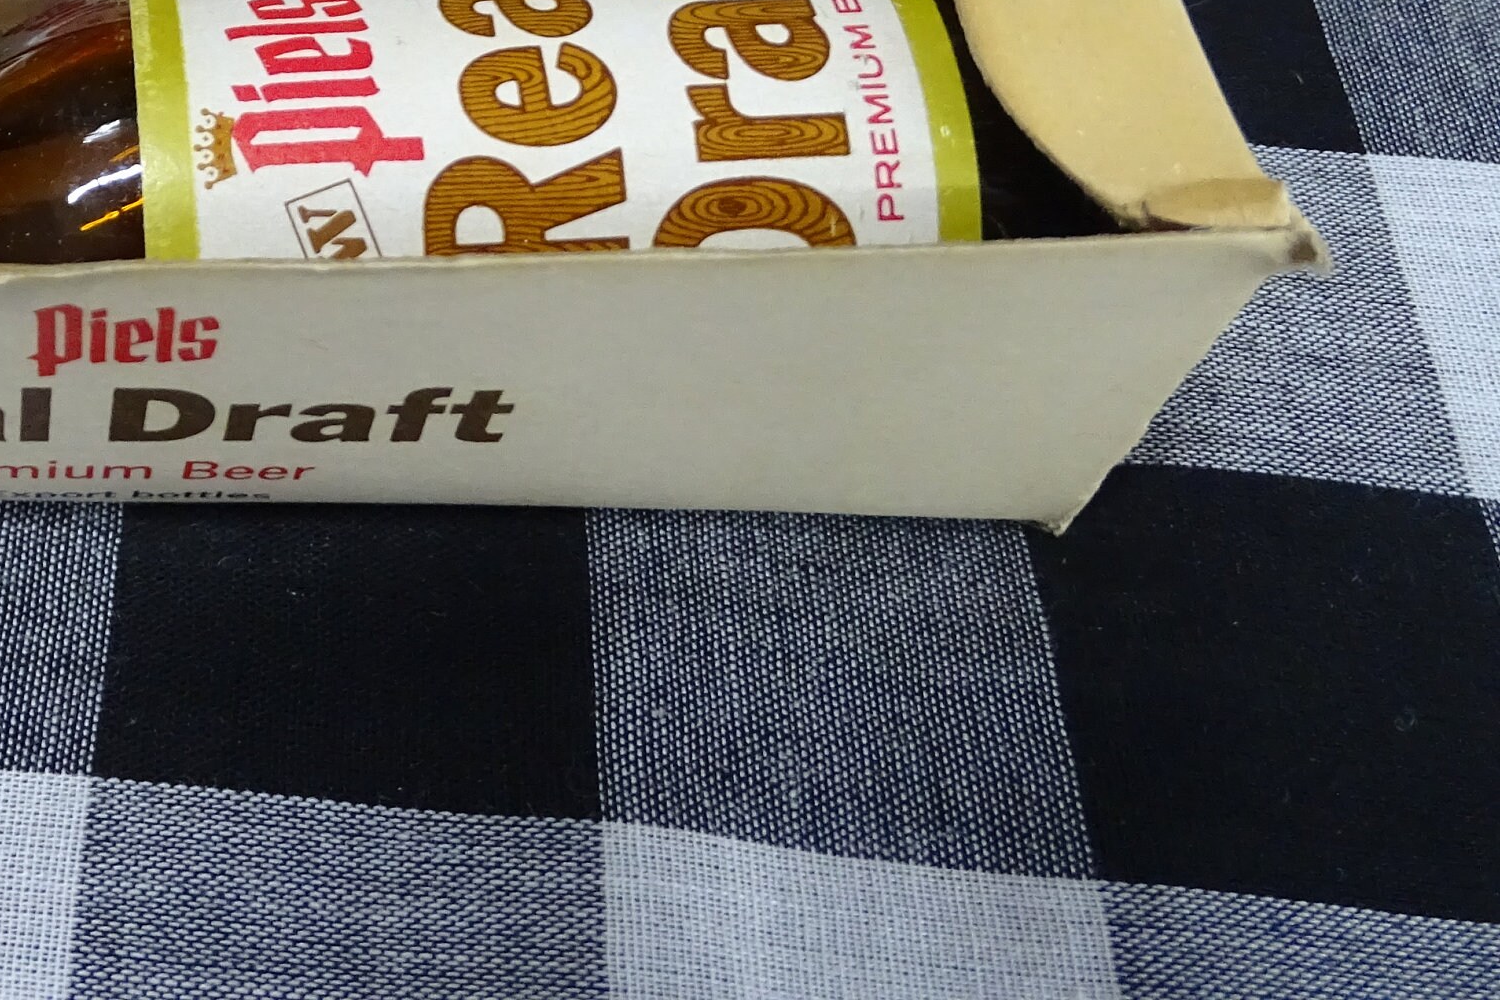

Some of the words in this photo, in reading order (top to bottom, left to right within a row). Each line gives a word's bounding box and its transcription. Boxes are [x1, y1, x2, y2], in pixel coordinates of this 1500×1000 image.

[843, 24, 904, 221] PREMIUM
[108, 386, 515, 444] Draft
[181, 460, 316, 481] Beer
